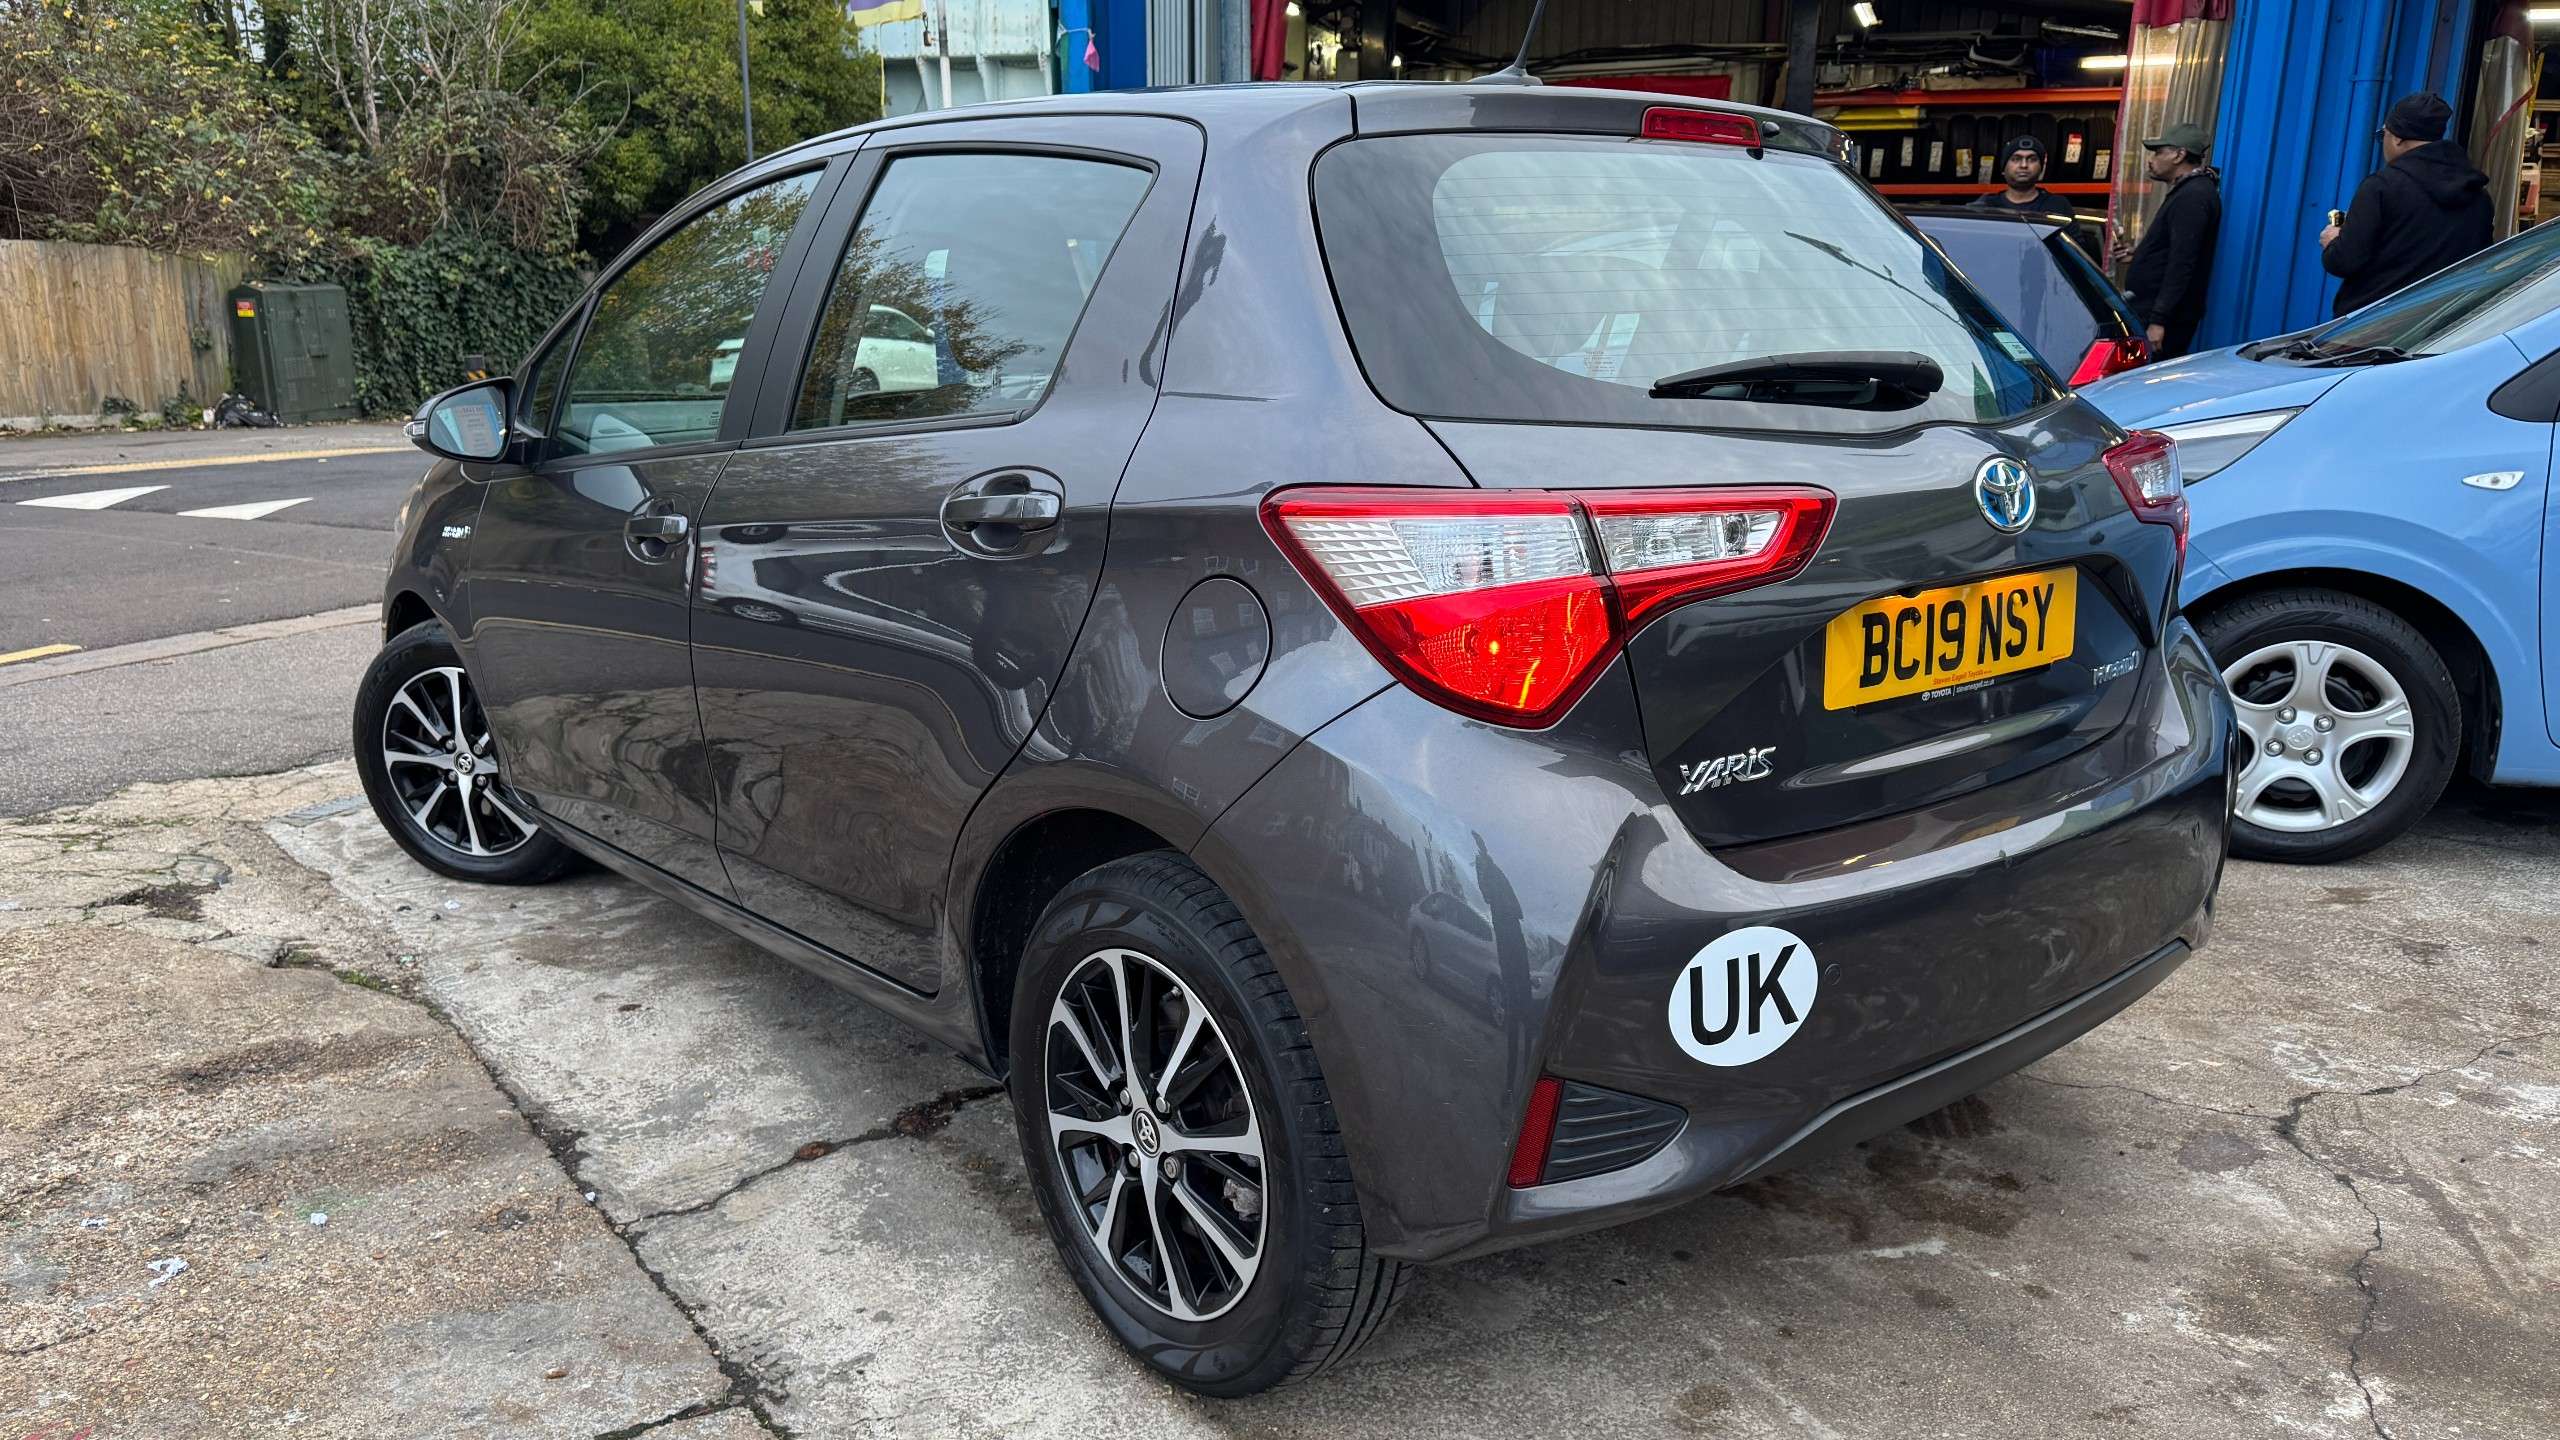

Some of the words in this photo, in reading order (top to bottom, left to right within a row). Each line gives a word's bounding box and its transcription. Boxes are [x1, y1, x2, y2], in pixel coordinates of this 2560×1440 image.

[1859, 600, 1967, 689] BC19
[1977, 583, 2056, 665] NSY
[1931, 687, 1952, 698] TOYOTA
[1689, 943, 1799, 1046] UK
